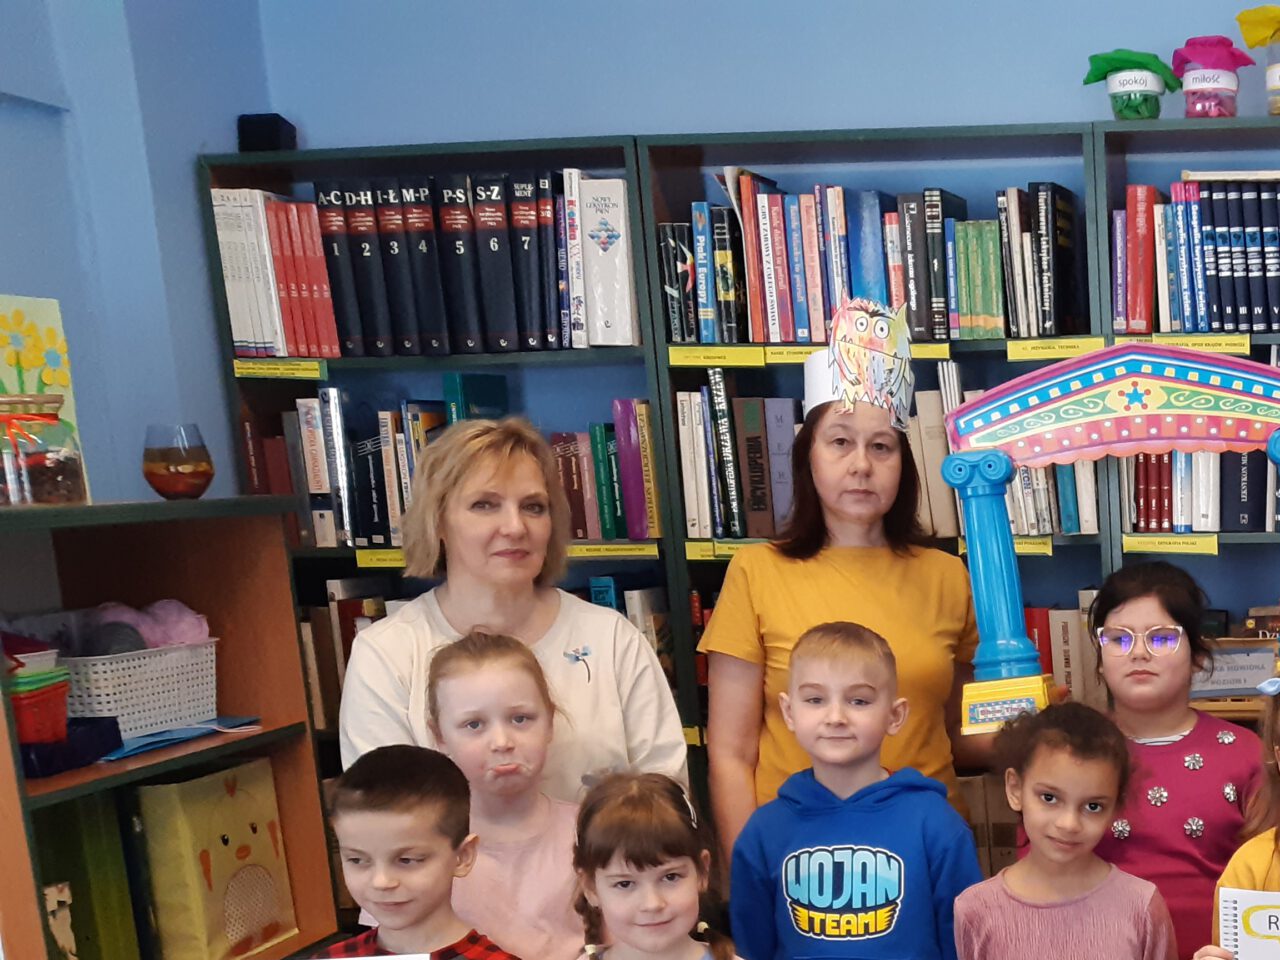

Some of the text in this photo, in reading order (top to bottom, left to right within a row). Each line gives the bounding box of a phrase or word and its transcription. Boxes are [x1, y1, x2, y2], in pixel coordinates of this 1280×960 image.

[1117, 74, 1149, 89] spokój
[1191, 73, 1222, 86] miłość
[318, 190, 342, 206] A-C
[344, 190, 373, 206] D-H
[401, 187, 430, 202] M-P
[443, 188, 466, 203] P-S
[476, 186, 501, 200] S-Z
[1191, 204, 1201, 244] Geografia
[332, 242, 340, 256] 1
[361, 242, 371, 256] 2
[389, 240, 399, 255] 3
[418, 239, 428, 253] 4
[455, 240, 465, 255] 5
[489, 237, 499, 251] 6
[521, 236, 531, 250] 7
[697, 234, 708, 304] Ptaki Europy
[1225, 306, 1232, 314] II
[1238, 306, 1247, 314] III
[1254, 306, 1263, 314] IV
[746, 436, 767, 512] ENCYKLOPEDIA
[1258, 627, 1280, 639] Dzi
[787, 849, 900, 910] WOJAN
[808, 910, 876, 936] TEAM
